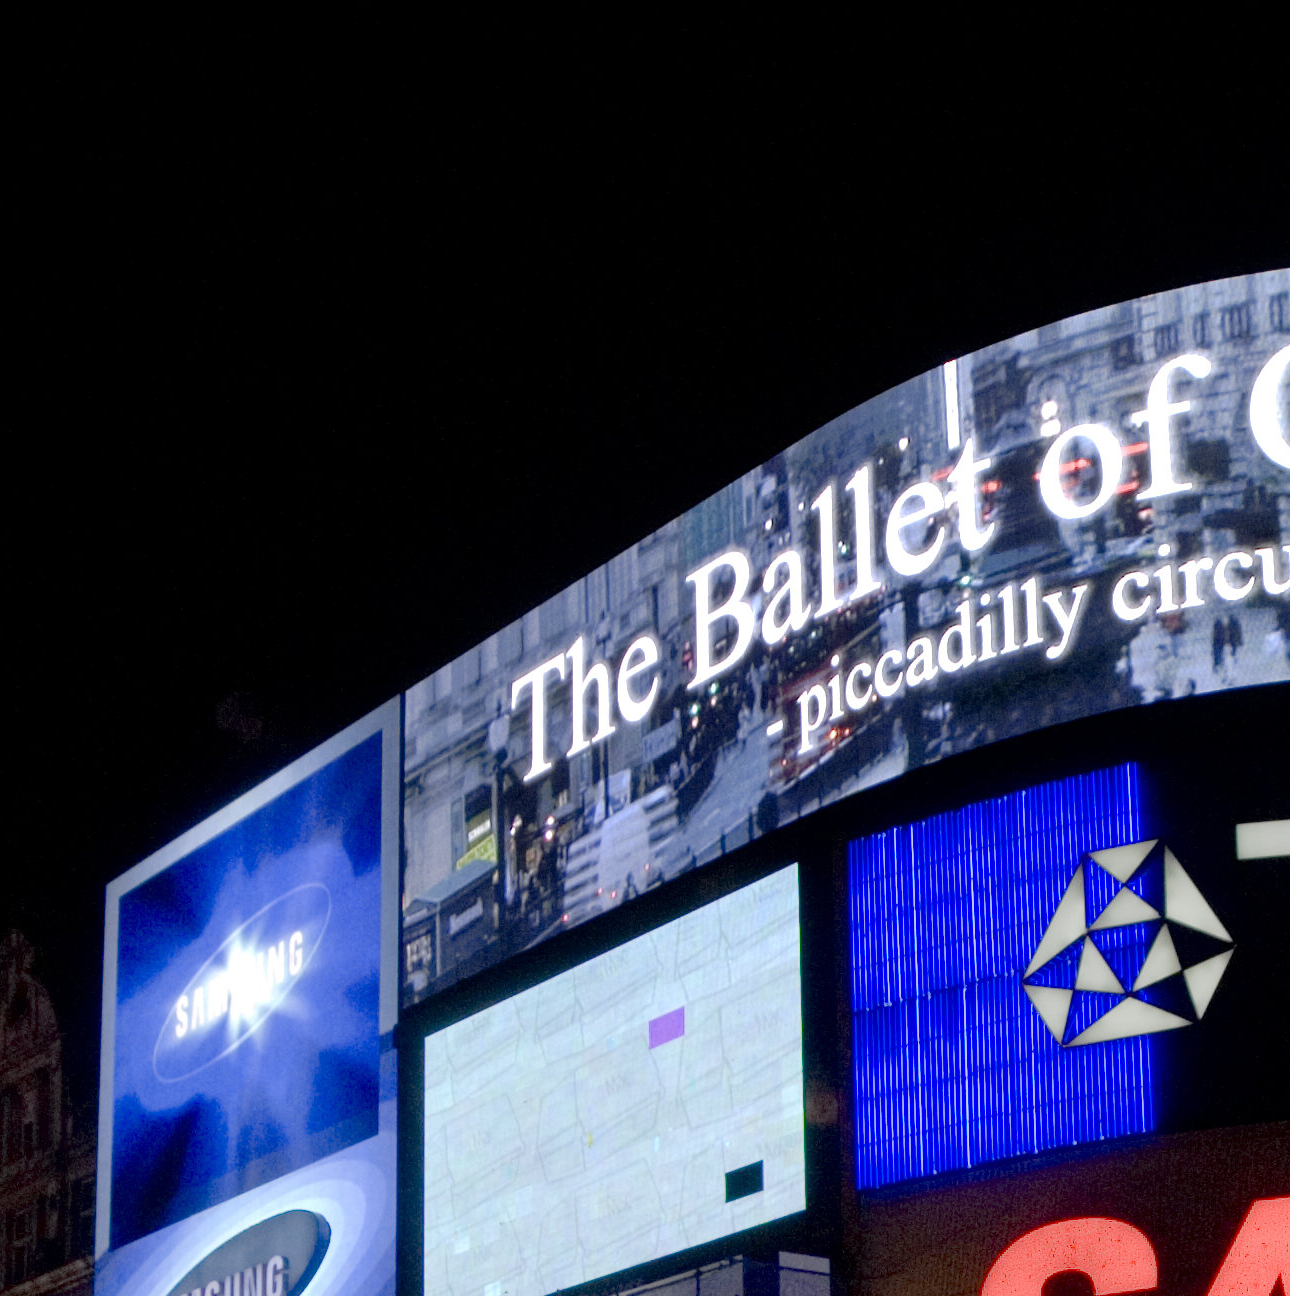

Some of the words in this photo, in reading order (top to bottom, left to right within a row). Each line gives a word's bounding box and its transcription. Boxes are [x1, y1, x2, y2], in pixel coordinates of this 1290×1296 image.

[511, 634, 660, 783] The
[685, 437, 996, 692] Ballet
[1039, 352, 1211, 522] of
[796, 576, 1090, 756] piccadilly
